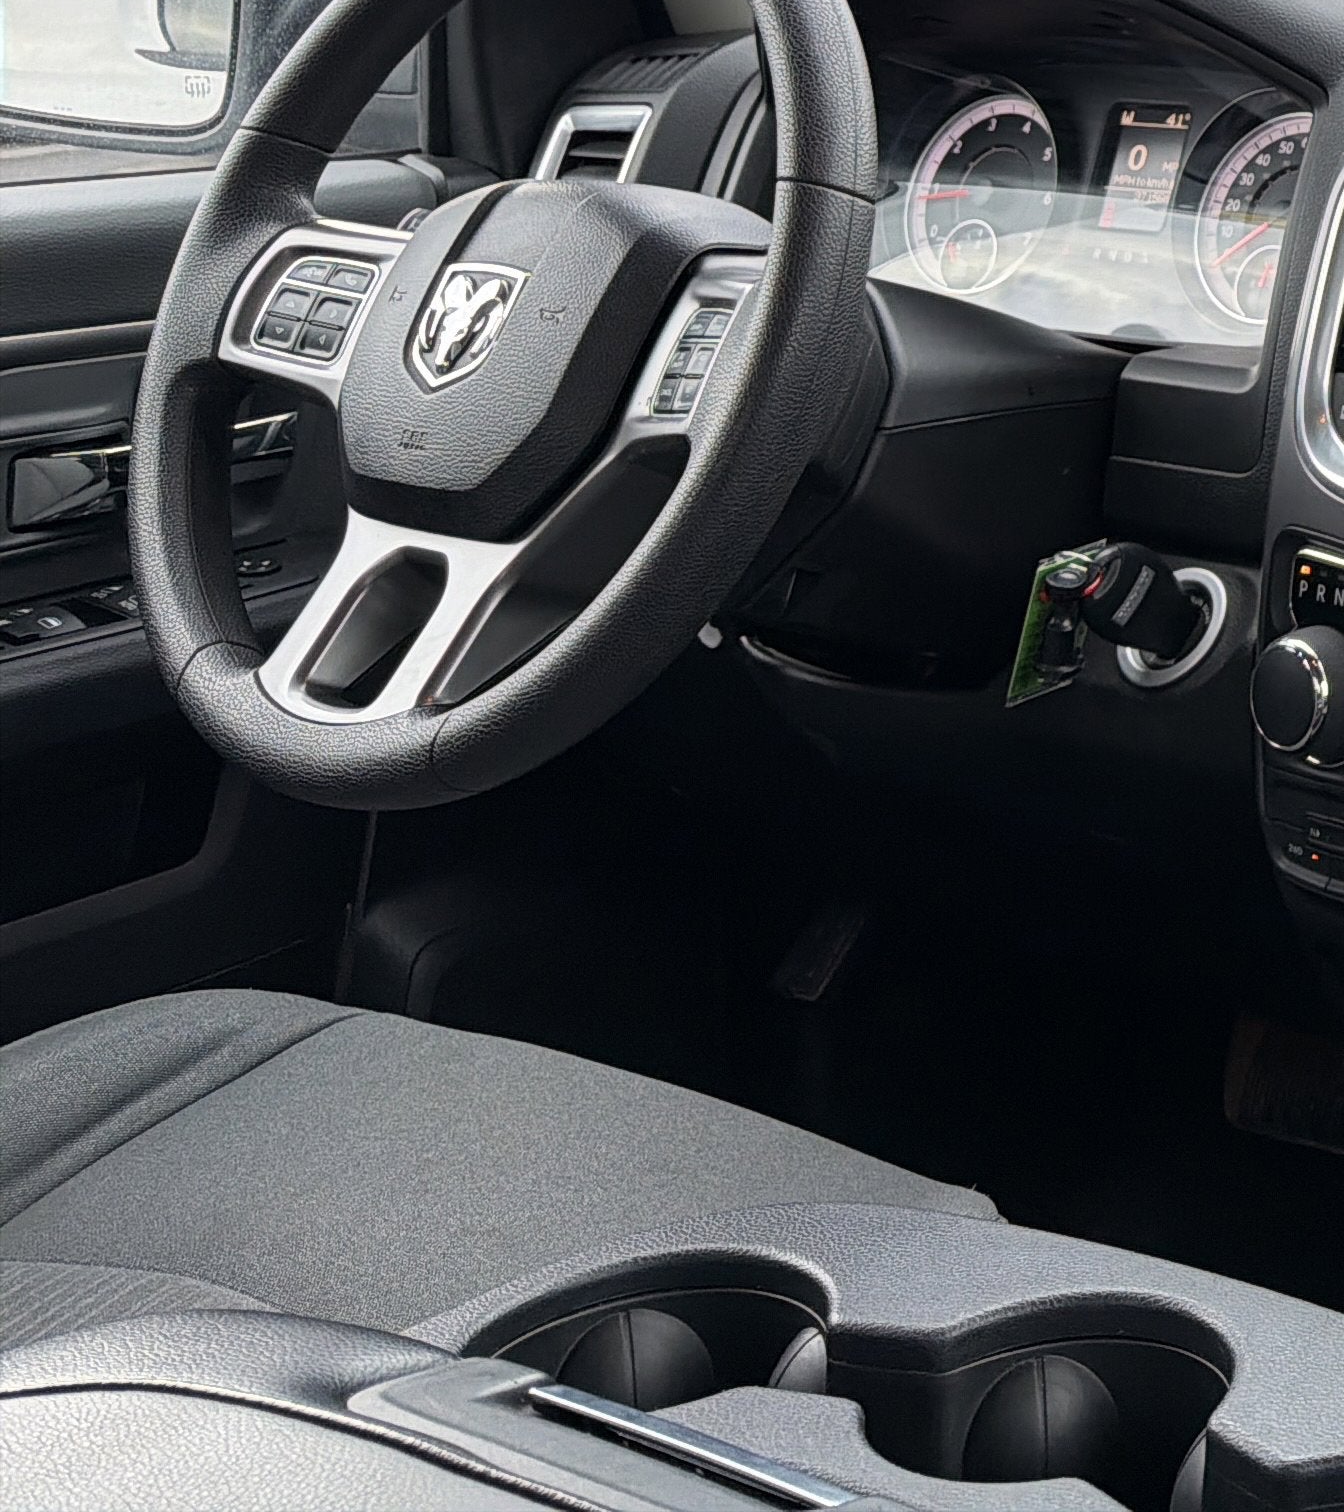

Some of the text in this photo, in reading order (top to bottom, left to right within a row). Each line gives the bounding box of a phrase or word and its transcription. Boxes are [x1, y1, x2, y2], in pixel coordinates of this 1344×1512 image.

[1022, 120, 1031, 134] 4
[953, 141, 962, 155] 2
[1042, 147, 1052, 162] 5
[1279, 140, 1295, 156] 50
[1128, 144, 1148, 171] 0
[1255, 153, 1271, 167] 40
[1239, 172, 1255, 187] 30
[1043, 192, 1052, 206] 6
[1225, 198, 1241, 213] 20
[1221, 225, 1234, 239] 10
[1298, 580, 1308, 599] P
[1316, 585, 1326, 604] R
[1334, 589, 1344, 608] N
